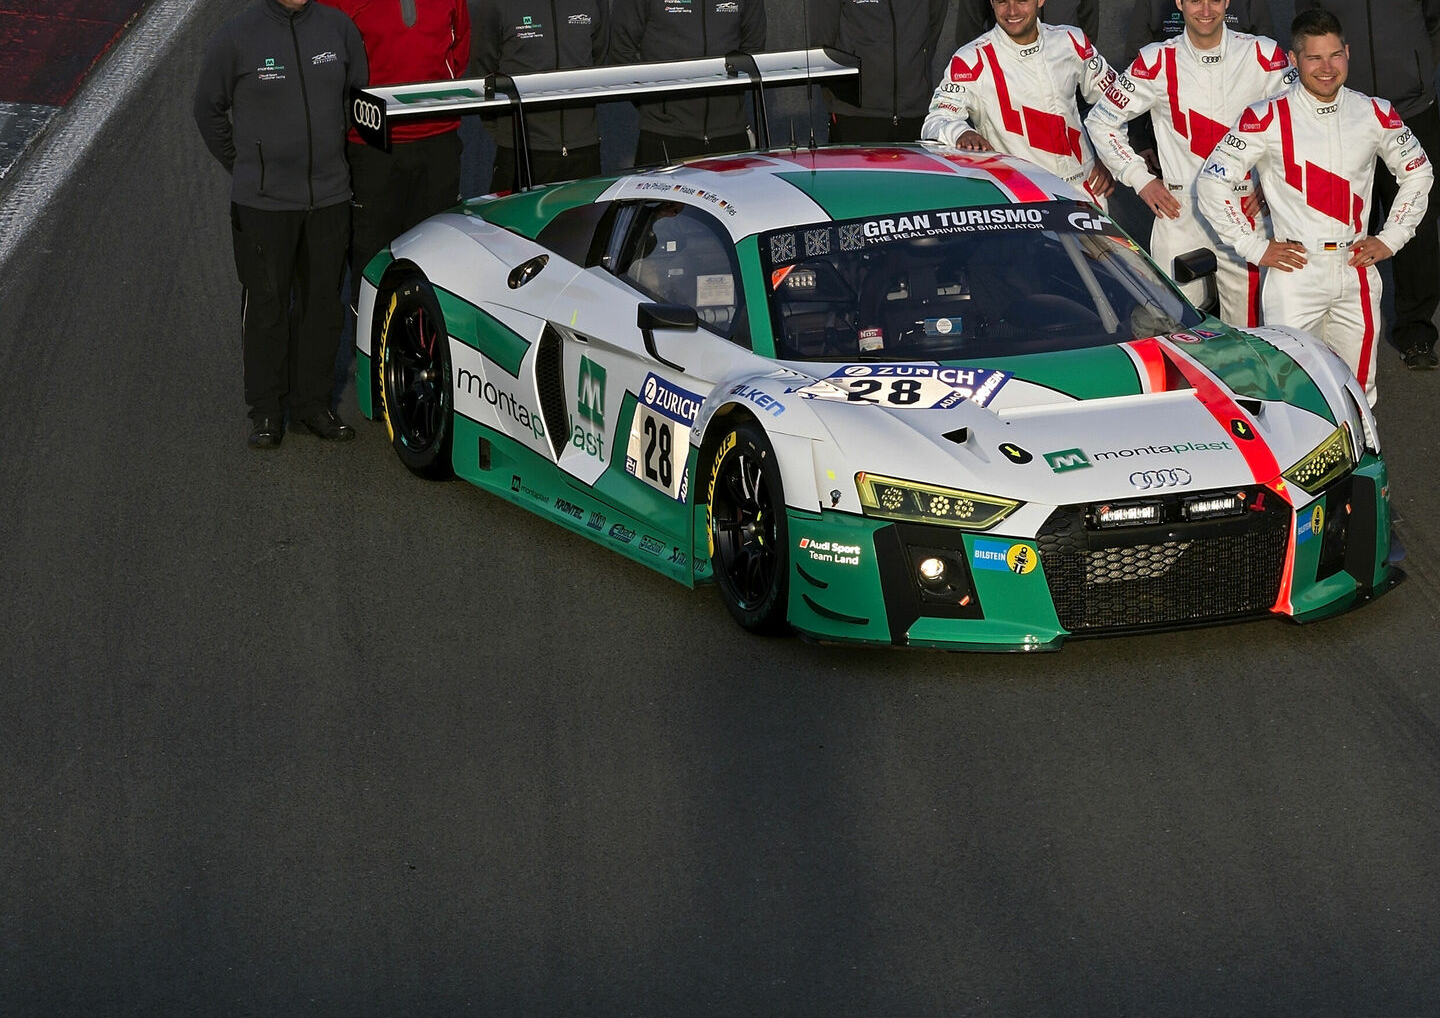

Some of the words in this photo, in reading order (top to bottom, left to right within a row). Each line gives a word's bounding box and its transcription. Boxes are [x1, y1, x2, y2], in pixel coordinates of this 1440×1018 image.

[863, 214, 931, 237] GRAN
[867, 234, 892, 244] THE
[893, 231, 925, 240] REAL
[927, 225, 974, 236] DRIVING
[977, 222, 1045, 231] SIMULATOR
[656, 386, 700, 421] ZURICH
[848, 379, 922, 405] 28
[644, 415, 672, 489] 28
[1093, 439, 1232, 462] montaplast
[809, 539, 830, 551] Audi
[831, 542, 861, 555] Sport
[809, 550, 833, 562] Team
[834, 553, 859, 565] Land
[974, 550, 1005, 562] BILSTEIN
